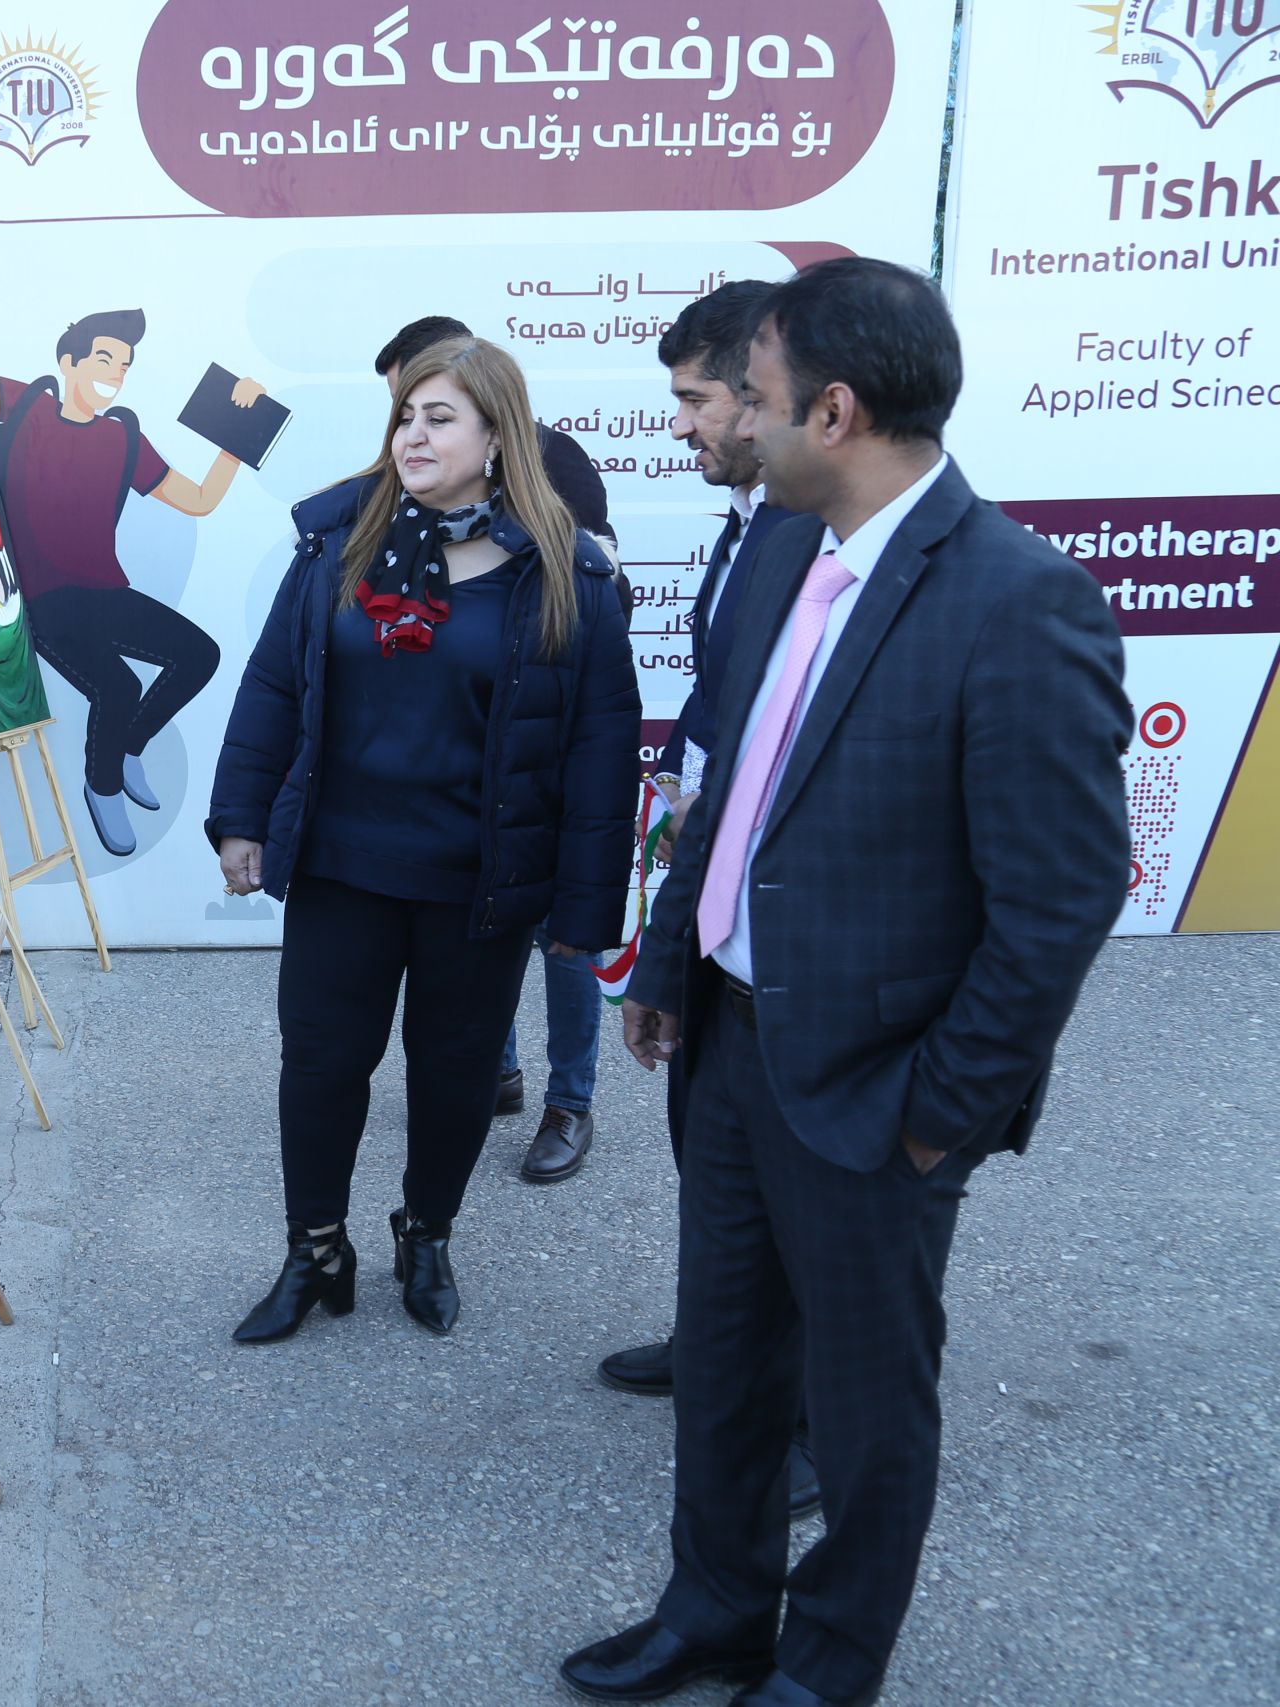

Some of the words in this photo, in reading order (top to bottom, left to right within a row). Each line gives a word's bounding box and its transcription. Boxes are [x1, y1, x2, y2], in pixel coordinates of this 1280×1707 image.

[1124, 0, 1143, 36] TISH
[200, 4, 409, 111] گەورە
[430, 16, 835, 101] دەرفەتێکی
[1121, 52, 1164, 65] ERBIL
[6, 78, 55, 117] TIU
[53, 62, 84, 110] UNIVERSITY
[60, 122, 84, 130] 2008
[199, 115, 379, 165] ئامادەیی
[480, 114, 581, 162] پۆلی
[592, 111, 780, 158] قوتابیانی
[791, 111, 833, 158] بۆ
[1097, 159, 1280, 222] Tishk
[989, 240, 1211, 277] International
[1221, 237, 1280, 269] Uni
[592, 315, 673, 345] وتوتان
[1076, 330, 1205, 367] Faculty
[1214, 327, 1254, 359] of
[1020, 379, 1160, 419] Applied
[1170, 377, 1280, 409] Scinec
[1102, 575, 1256, 612] rtment
